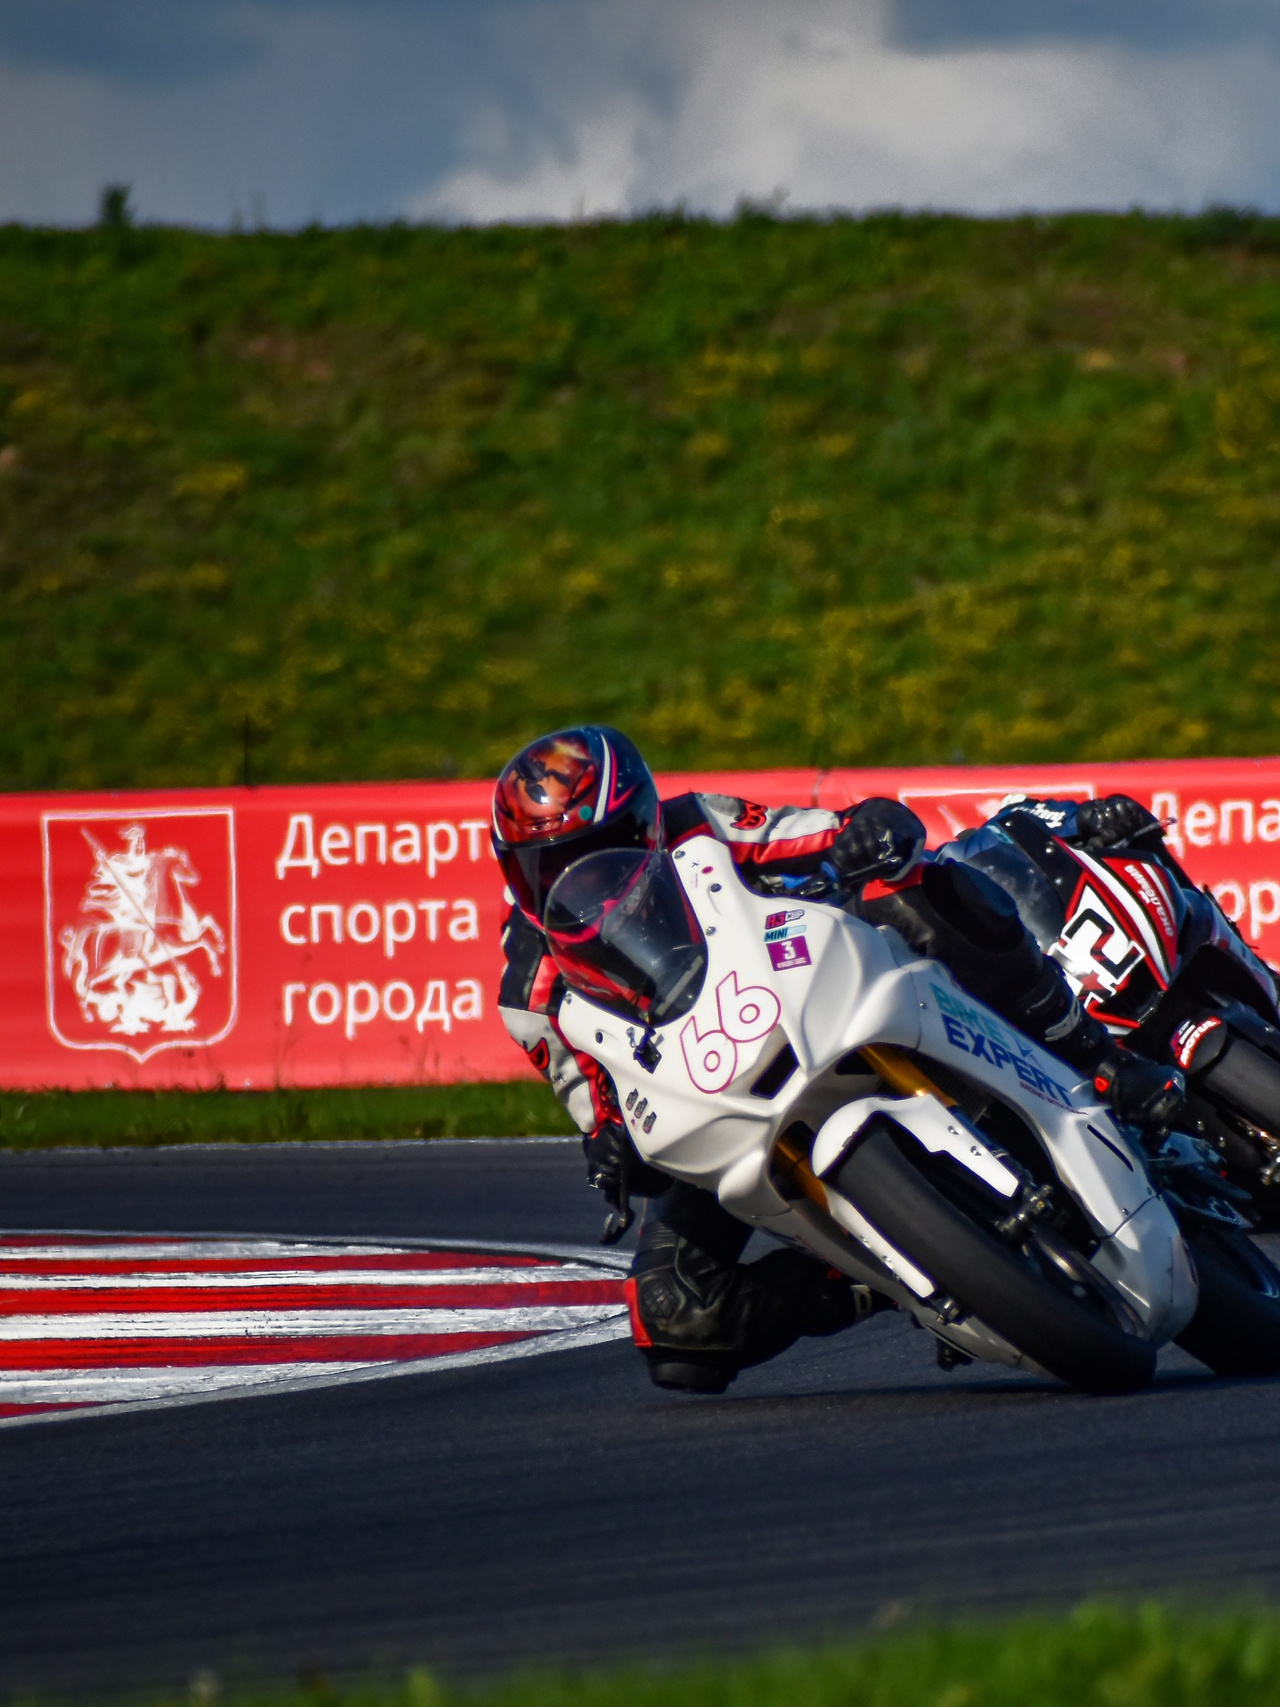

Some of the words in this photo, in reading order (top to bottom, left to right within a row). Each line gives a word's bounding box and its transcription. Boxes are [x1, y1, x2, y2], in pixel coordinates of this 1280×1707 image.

[275, 812, 499, 880] Департ
[279, 898, 480, 958] спорта
[764, 927, 788, 942] MINI
[781, 940, 797, 960] 3
[282, 978, 484, 1040] города
[680, 970, 781, 1094] 66
[929, 982, 1012, 1050] BIKE
[940, 1012, 1074, 1108] EXPERT
[1180, 1019, 1218, 1066] MOTUL
